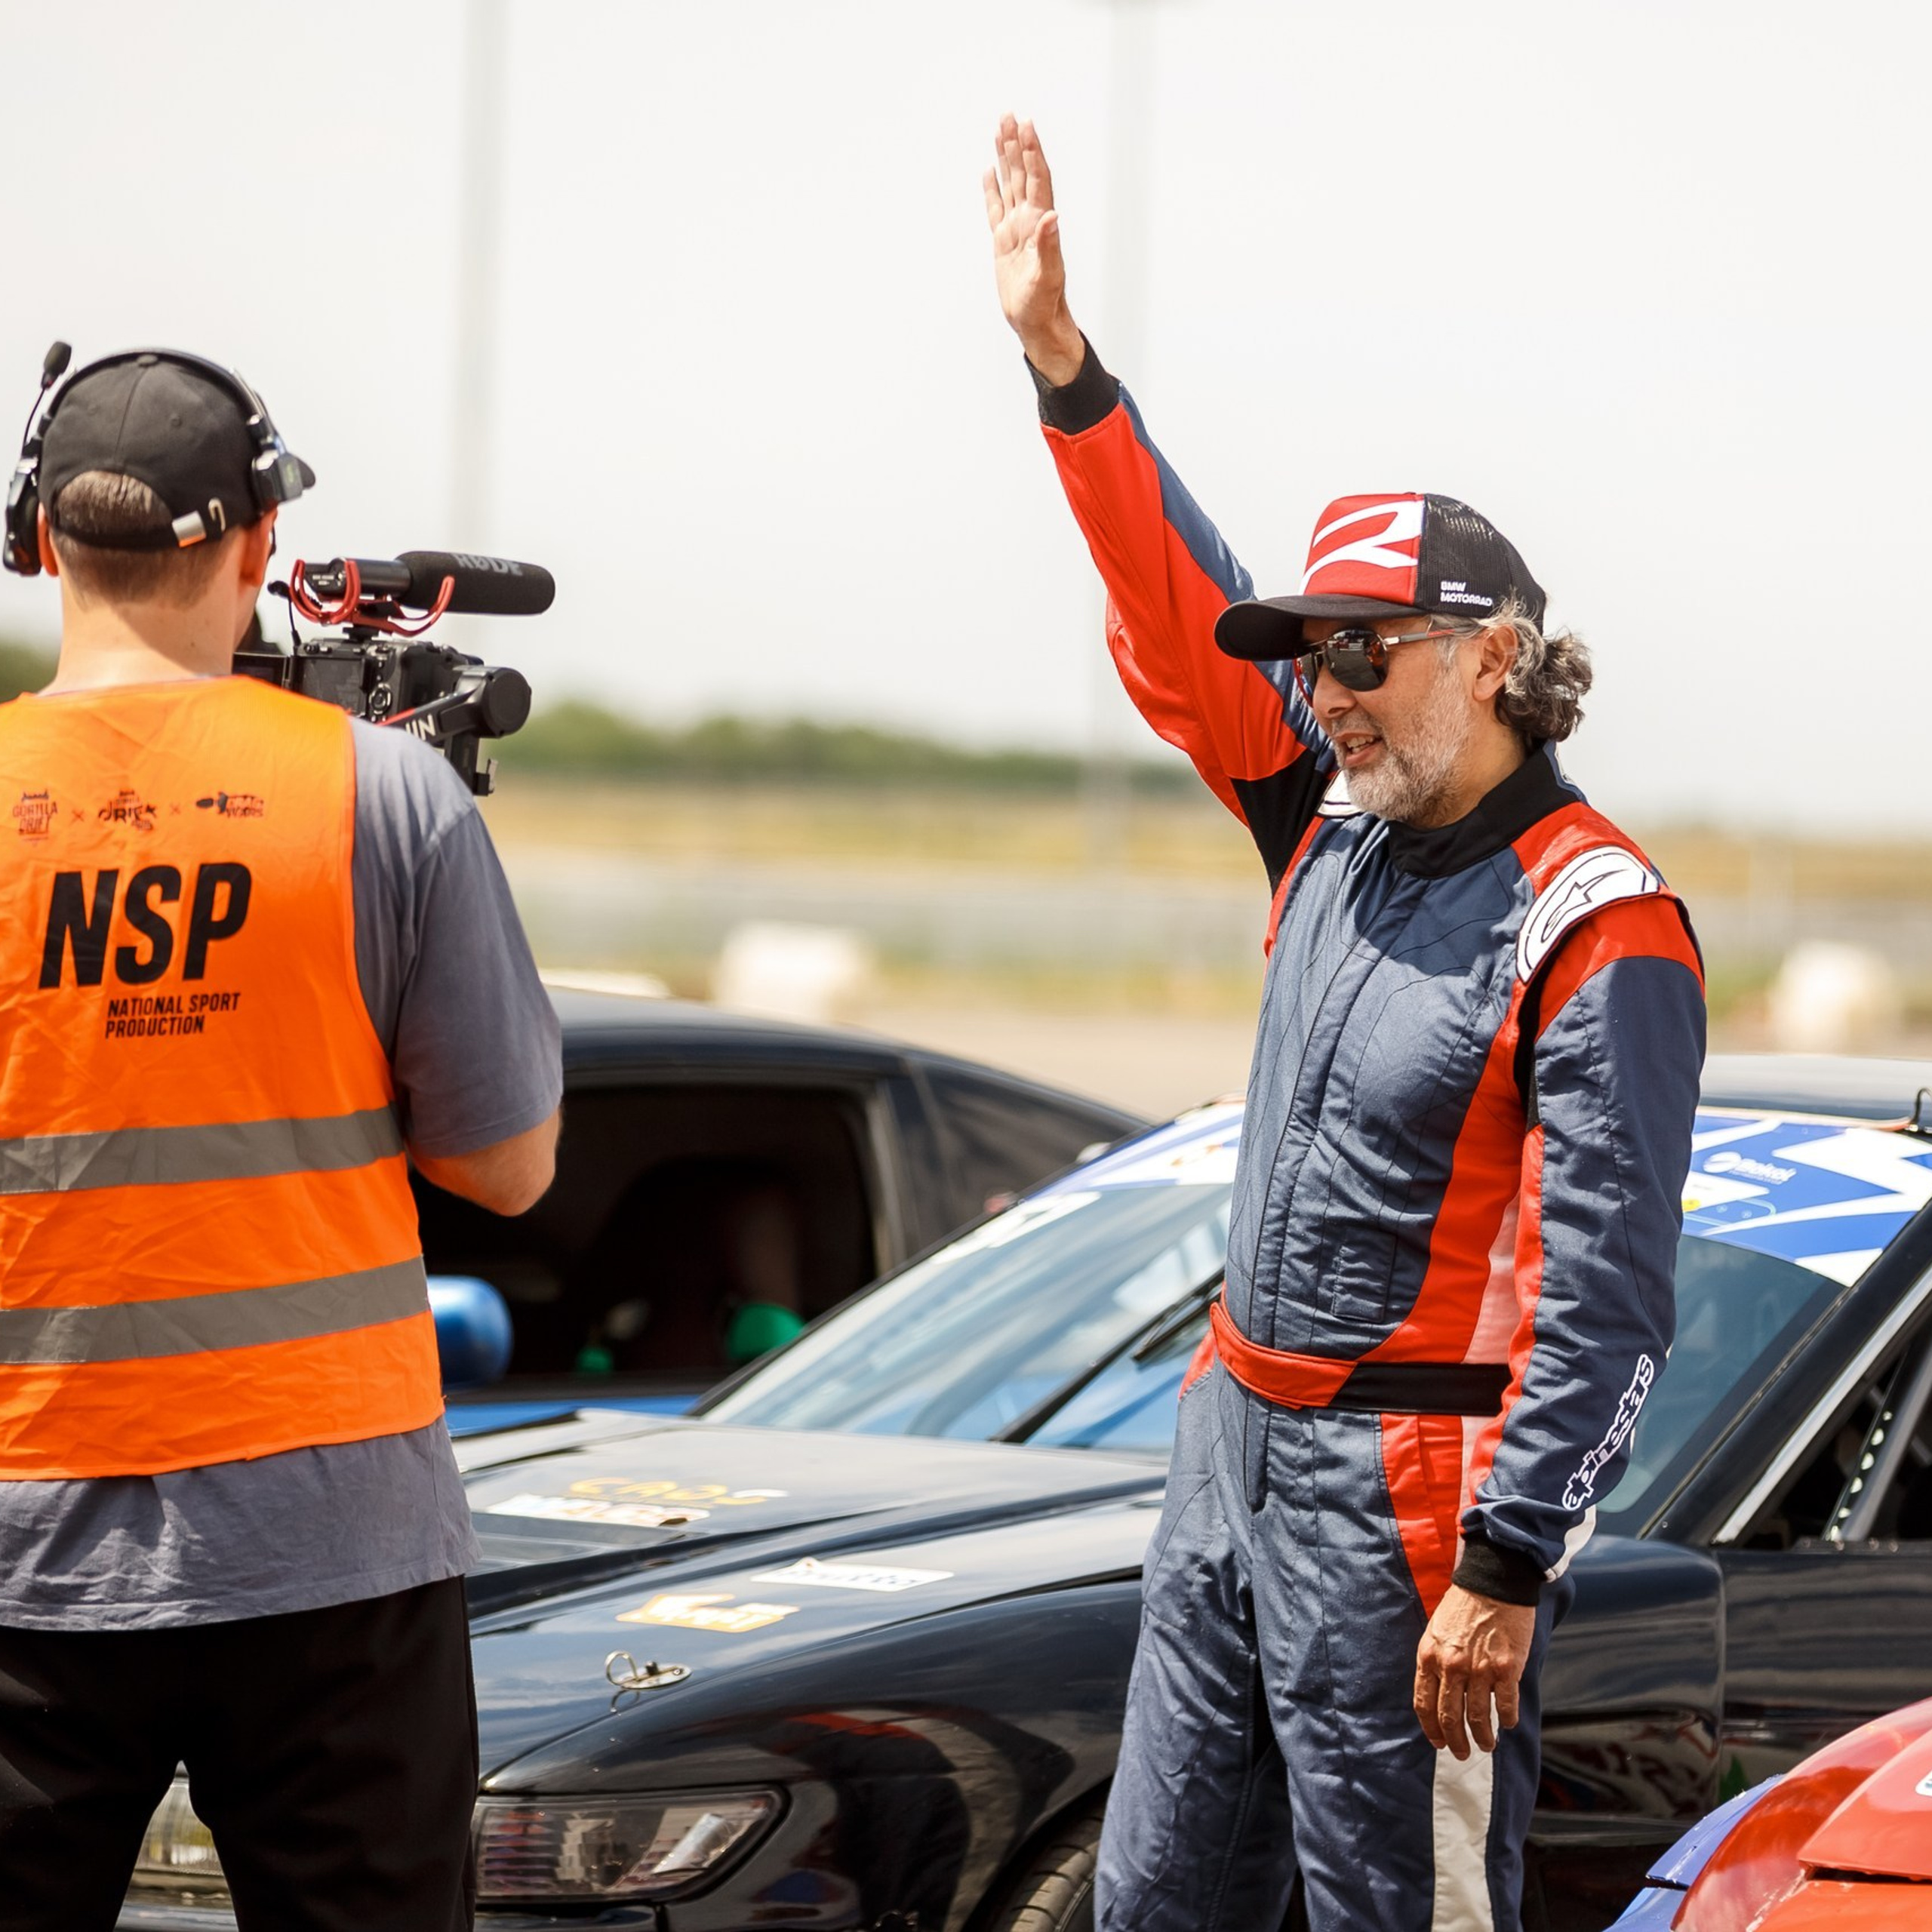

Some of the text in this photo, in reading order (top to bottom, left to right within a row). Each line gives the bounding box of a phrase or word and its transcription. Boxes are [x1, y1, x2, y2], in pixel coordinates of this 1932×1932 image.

[1440, 580, 1466, 592] BMW
[1440, 592, 1493, 607] MOTORRAD
[38, 862, 251, 989] NSP
[108, 992, 241, 1018] NATIONAL SPORT
[105, 1015, 205, 1039] PRODUCTION
